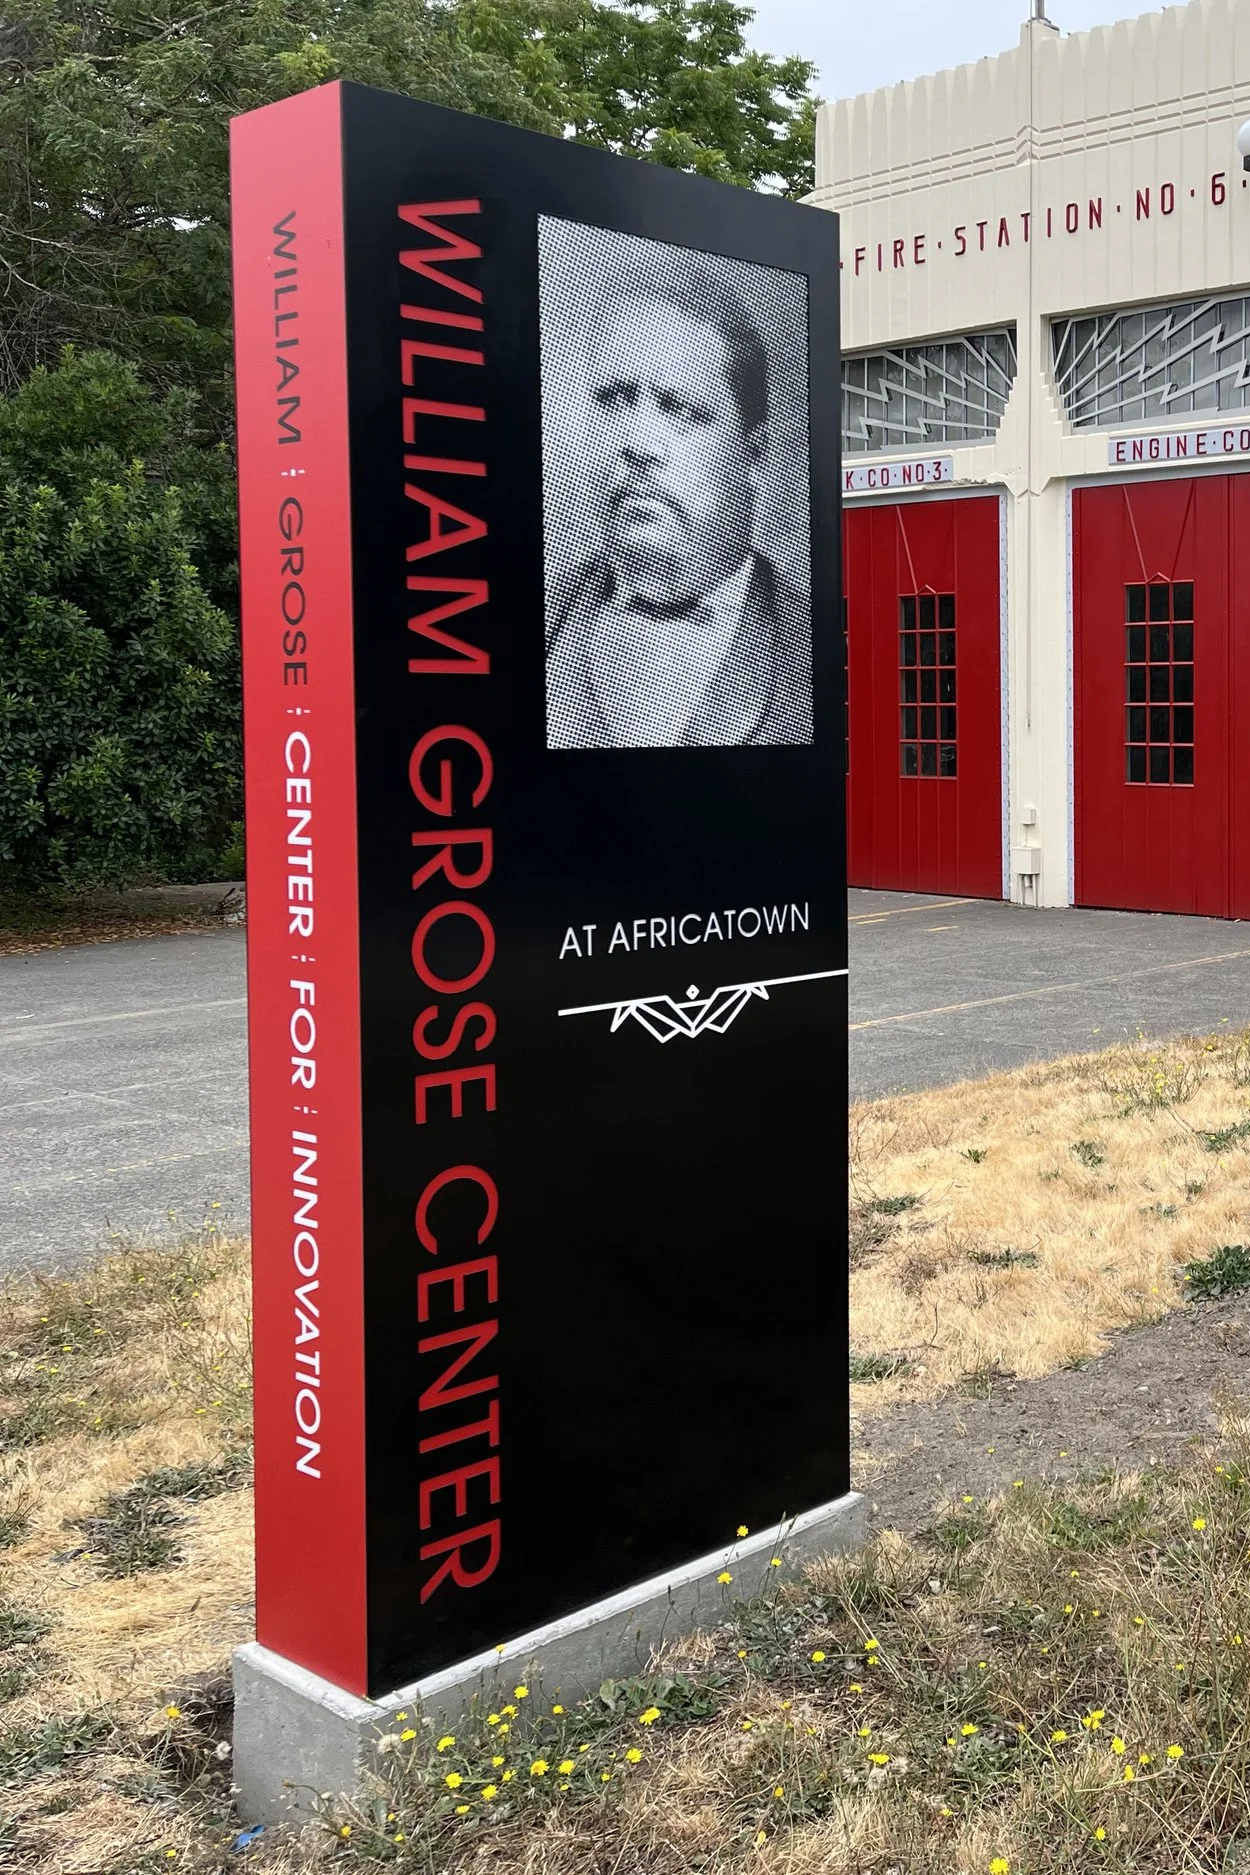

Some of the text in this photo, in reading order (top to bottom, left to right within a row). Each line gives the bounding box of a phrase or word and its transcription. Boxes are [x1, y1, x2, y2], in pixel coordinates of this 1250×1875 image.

[854, 234, 926, 276] FIRE
[954, 197, 1103, 256] STATION
[1136, 182, 1175, 221] NO
[868, 468, 890, 487] CO
[902, 463, 925, 484] NO
[1115, 433, 1208, 462] ENGINE
[1223, 429, 1250, 452] CO
[273, 210, 321, 1479] WILLIAM GROSE CENTER FOR INNOVATION
[398, 199, 502, 1603] WILLIAM GROSE CENTER
[558, 902, 809, 960] AT AFRICATOWN
